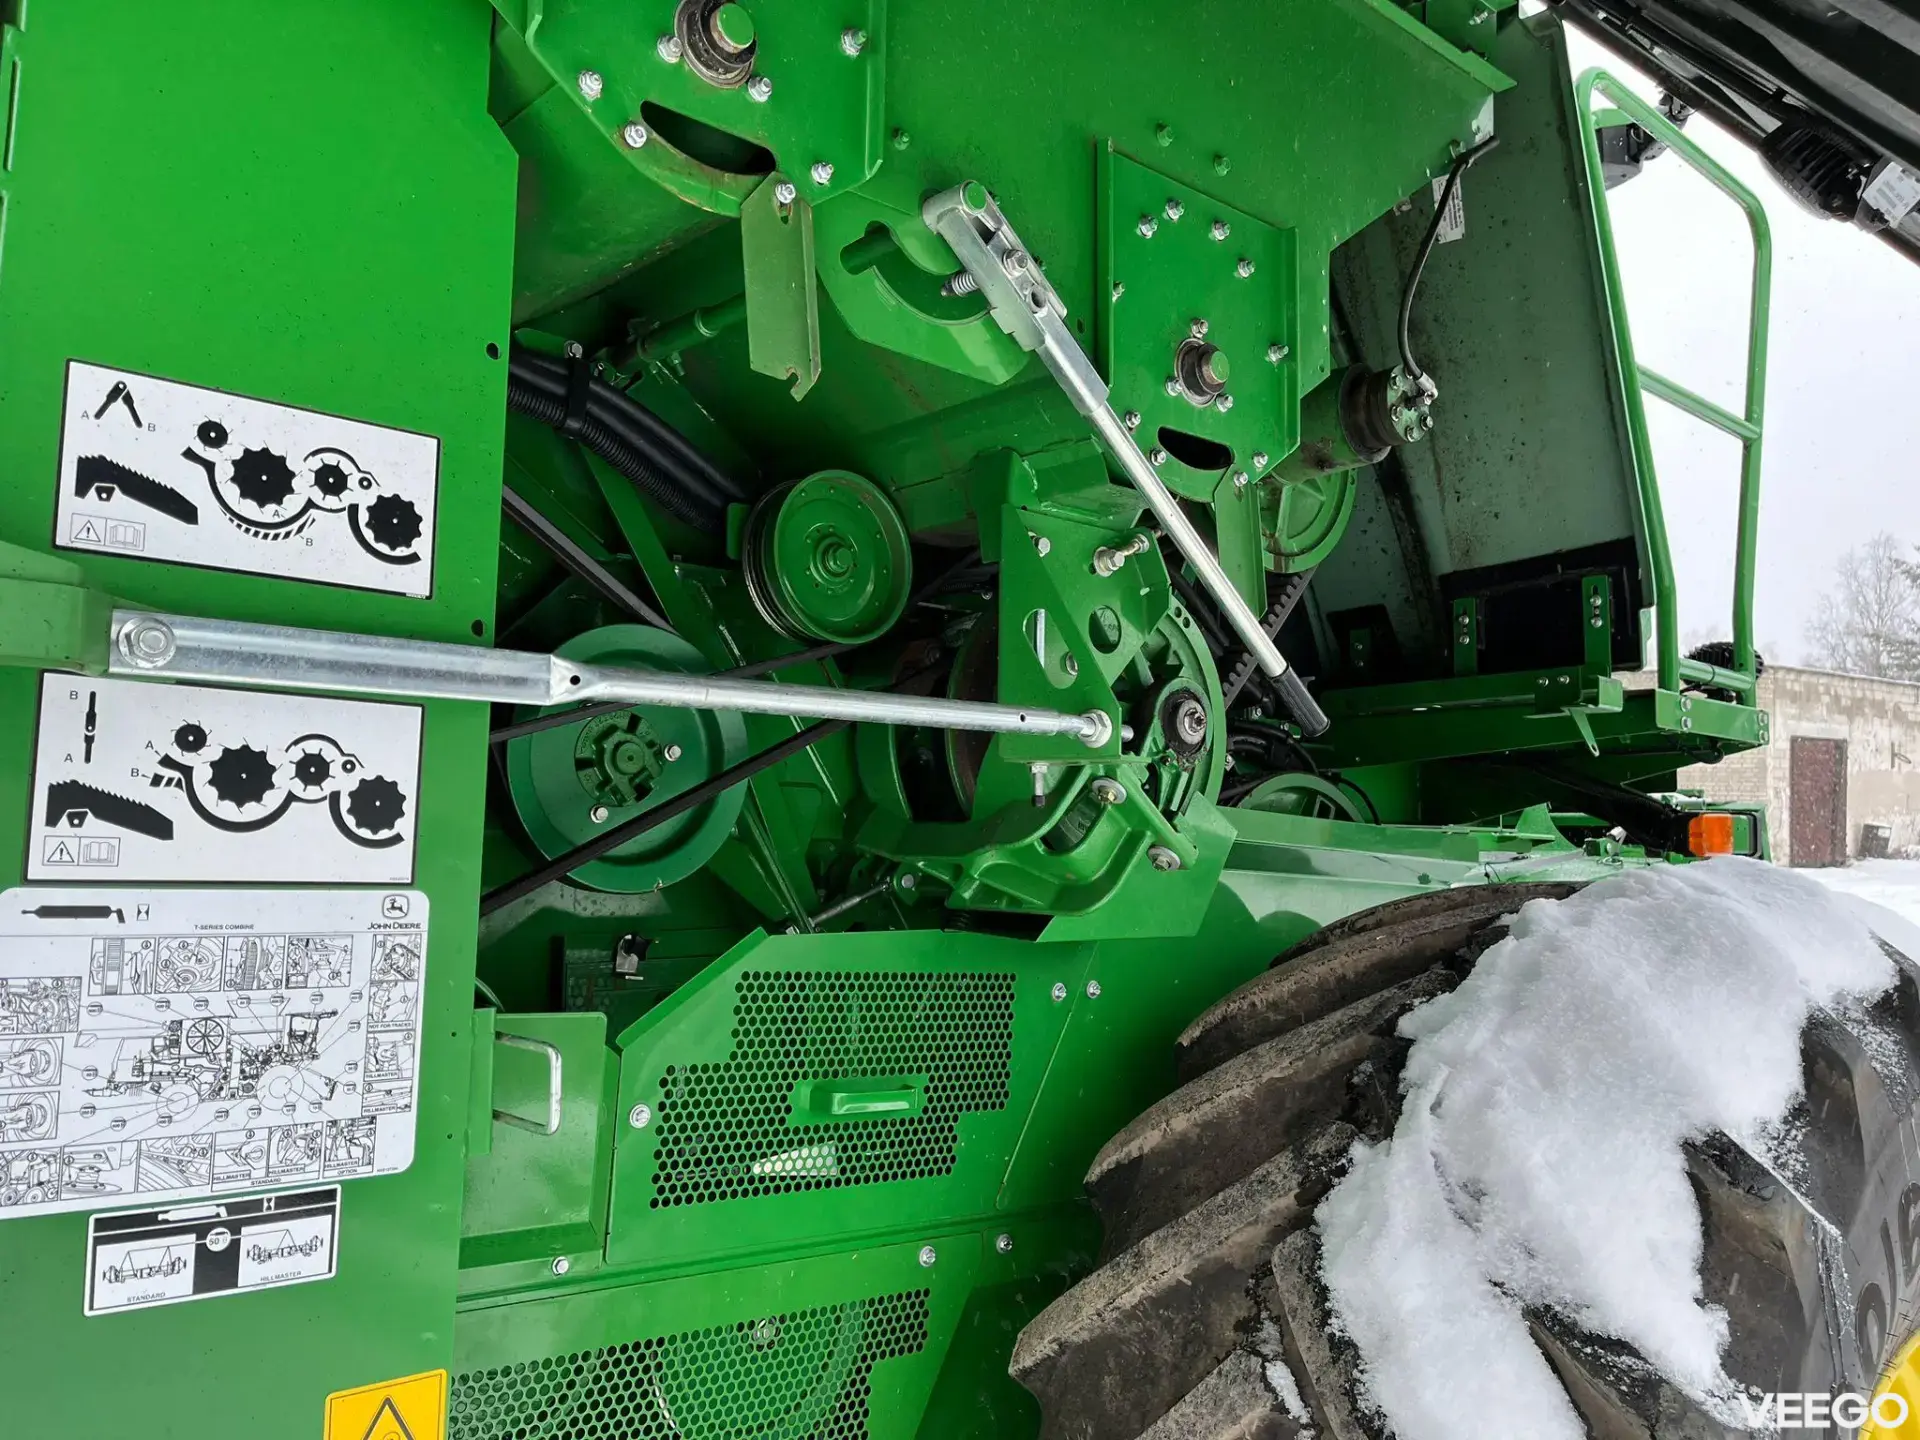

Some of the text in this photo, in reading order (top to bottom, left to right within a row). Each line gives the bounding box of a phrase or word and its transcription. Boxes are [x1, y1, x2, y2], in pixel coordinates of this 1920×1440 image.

[80, 410, 90, 420] A
[147, 422, 156, 432] B
[272, 509, 281, 519] A
[305, 537, 314, 547] B
[69, 690, 79, 700] B
[144, 740, 155, 750] A
[63, 753, 74, 763] A
[130, 767, 140, 778] B
[367, 921, 422, 930] JOHN DEERE
[325, 1160, 358, 1168] HILLMASTER
[269, 1166, 304, 1175] HILLMASTER
[337, 1168, 358, 1176] OPTION
[213, 1173, 251, 1181] HILLMASTER
[250, 1178, 282, 1186] STANDARD
[208, 1237, 220, 1246] 50
[260, 1270, 302, 1282] HILLMASTER
[126, 1291, 166, 1303] STANDARD
